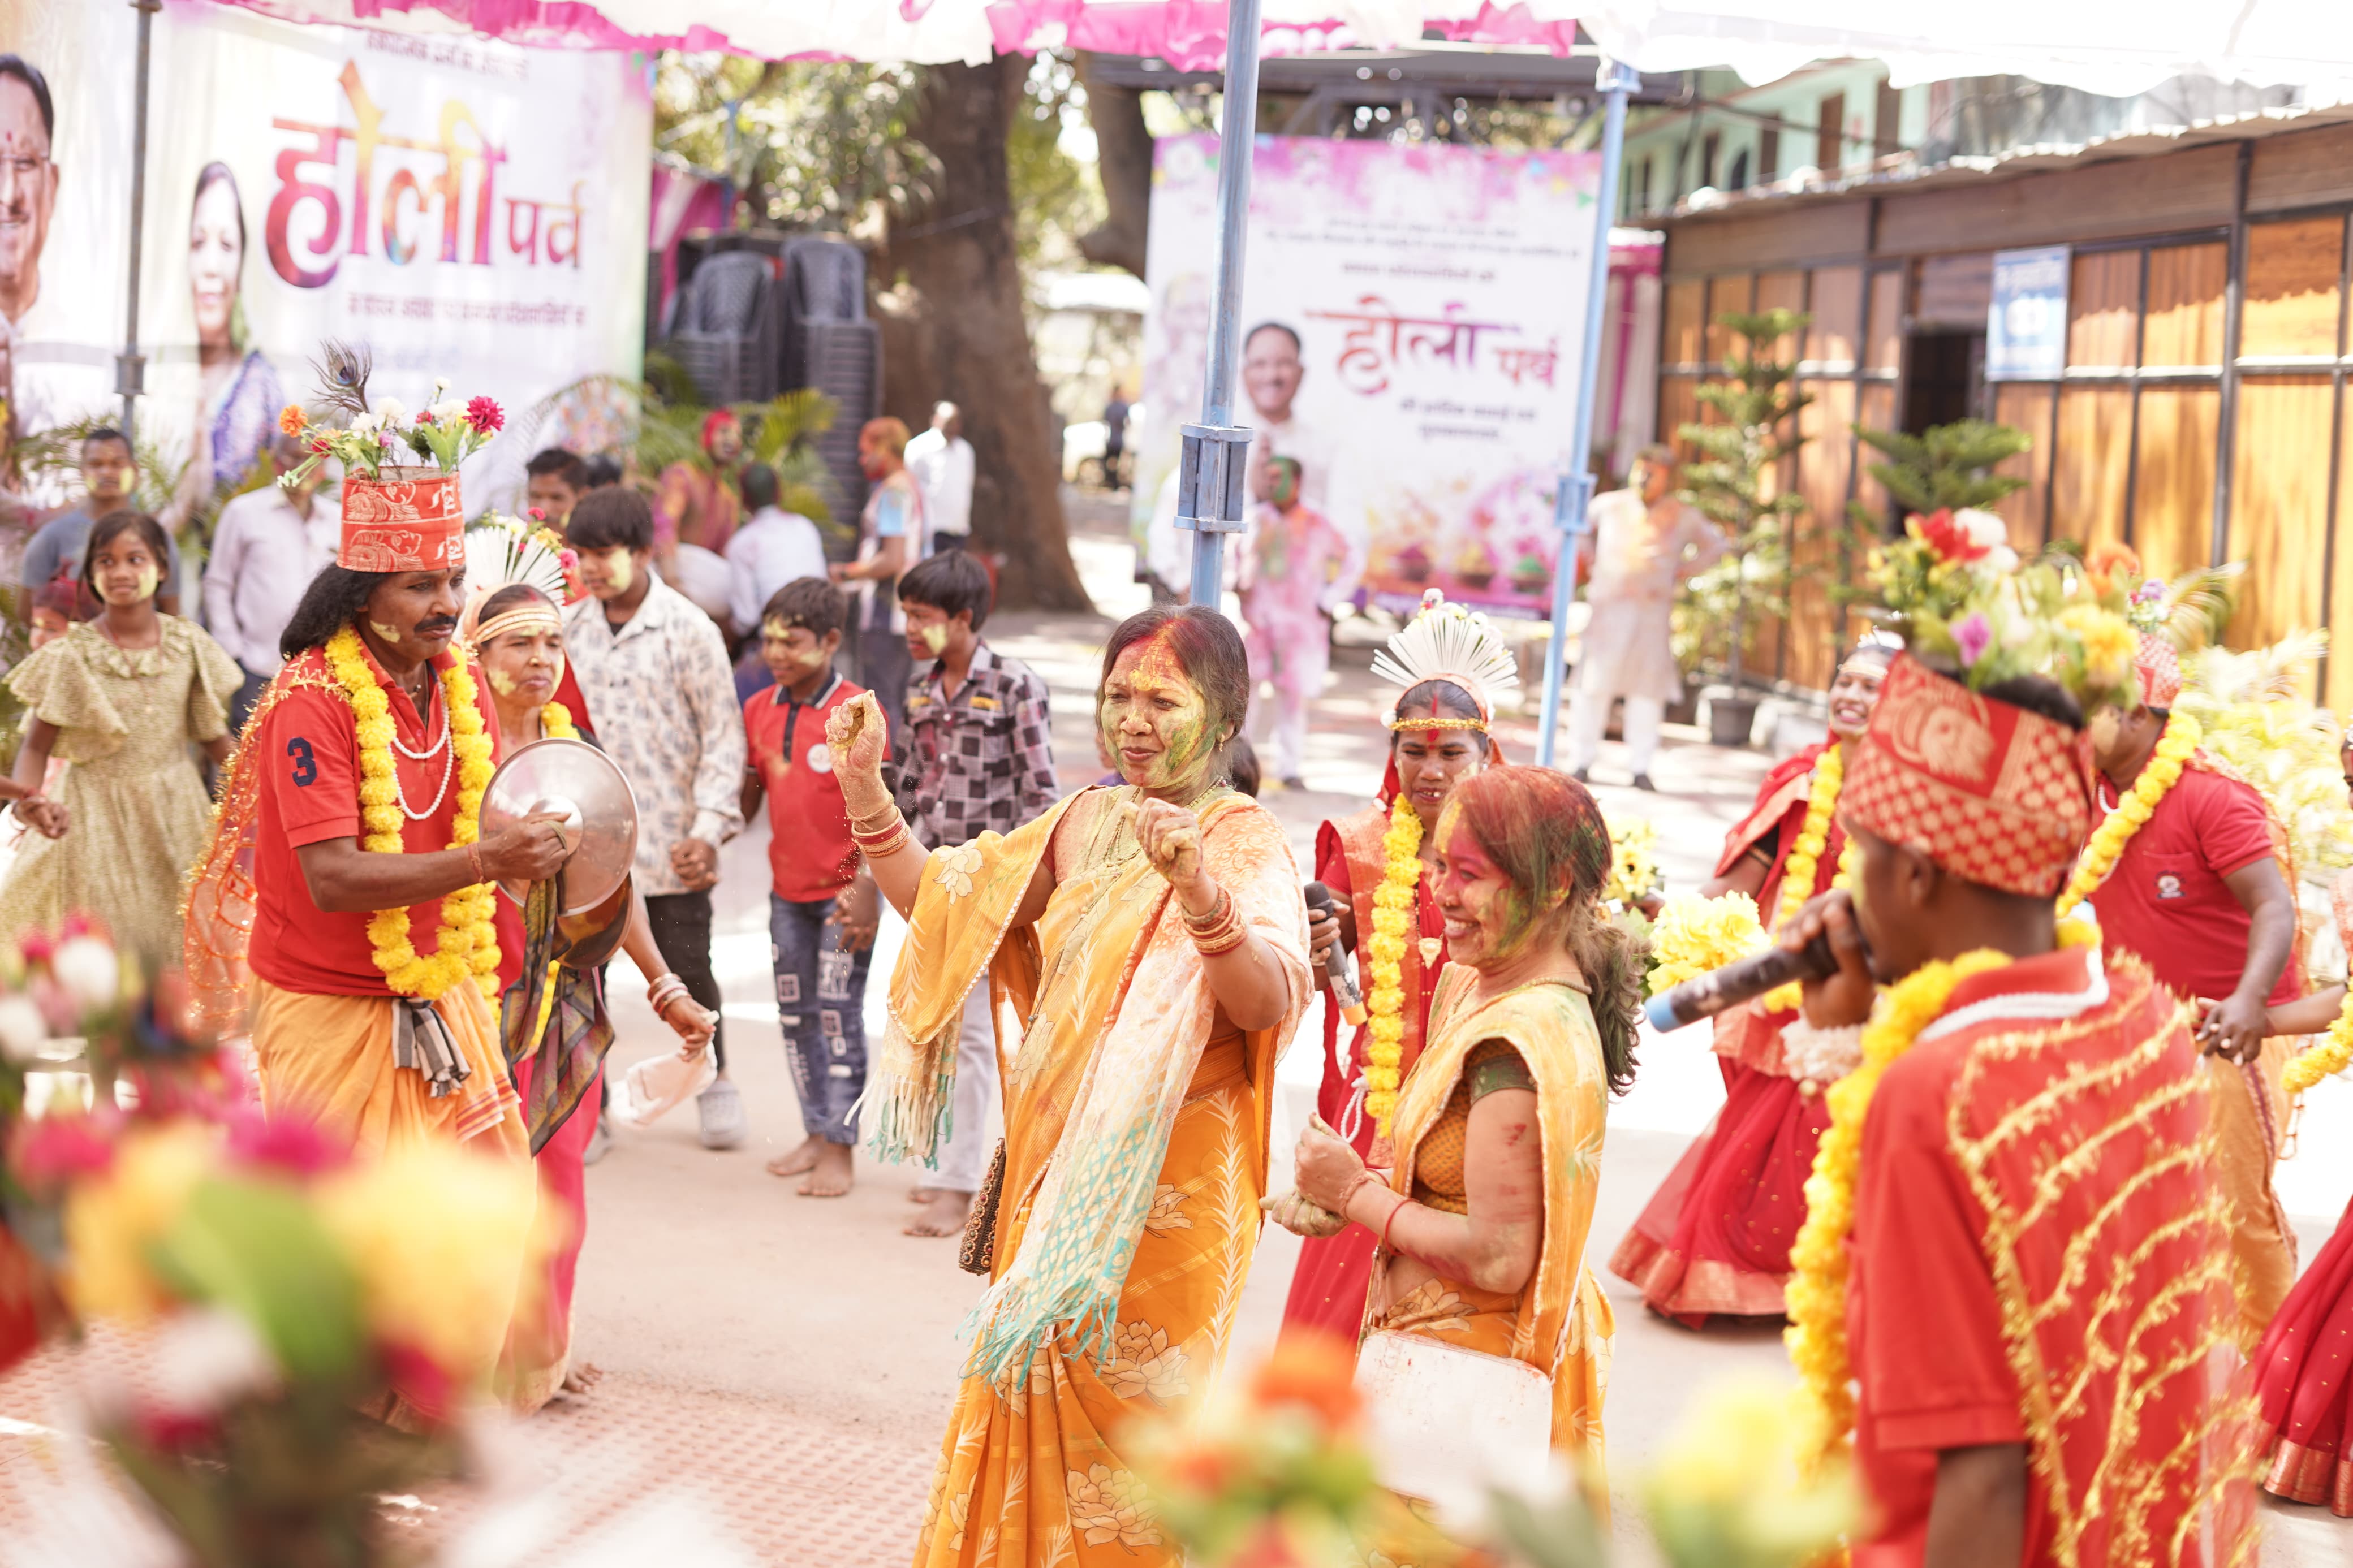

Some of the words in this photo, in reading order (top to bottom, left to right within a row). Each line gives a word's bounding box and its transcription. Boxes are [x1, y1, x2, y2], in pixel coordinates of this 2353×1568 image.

[265, 58, 507, 289] होली
[505, 179, 586, 269] पर्व
[1303, 294, 1522, 396] होली
[287, 737, 318, 788] 3
